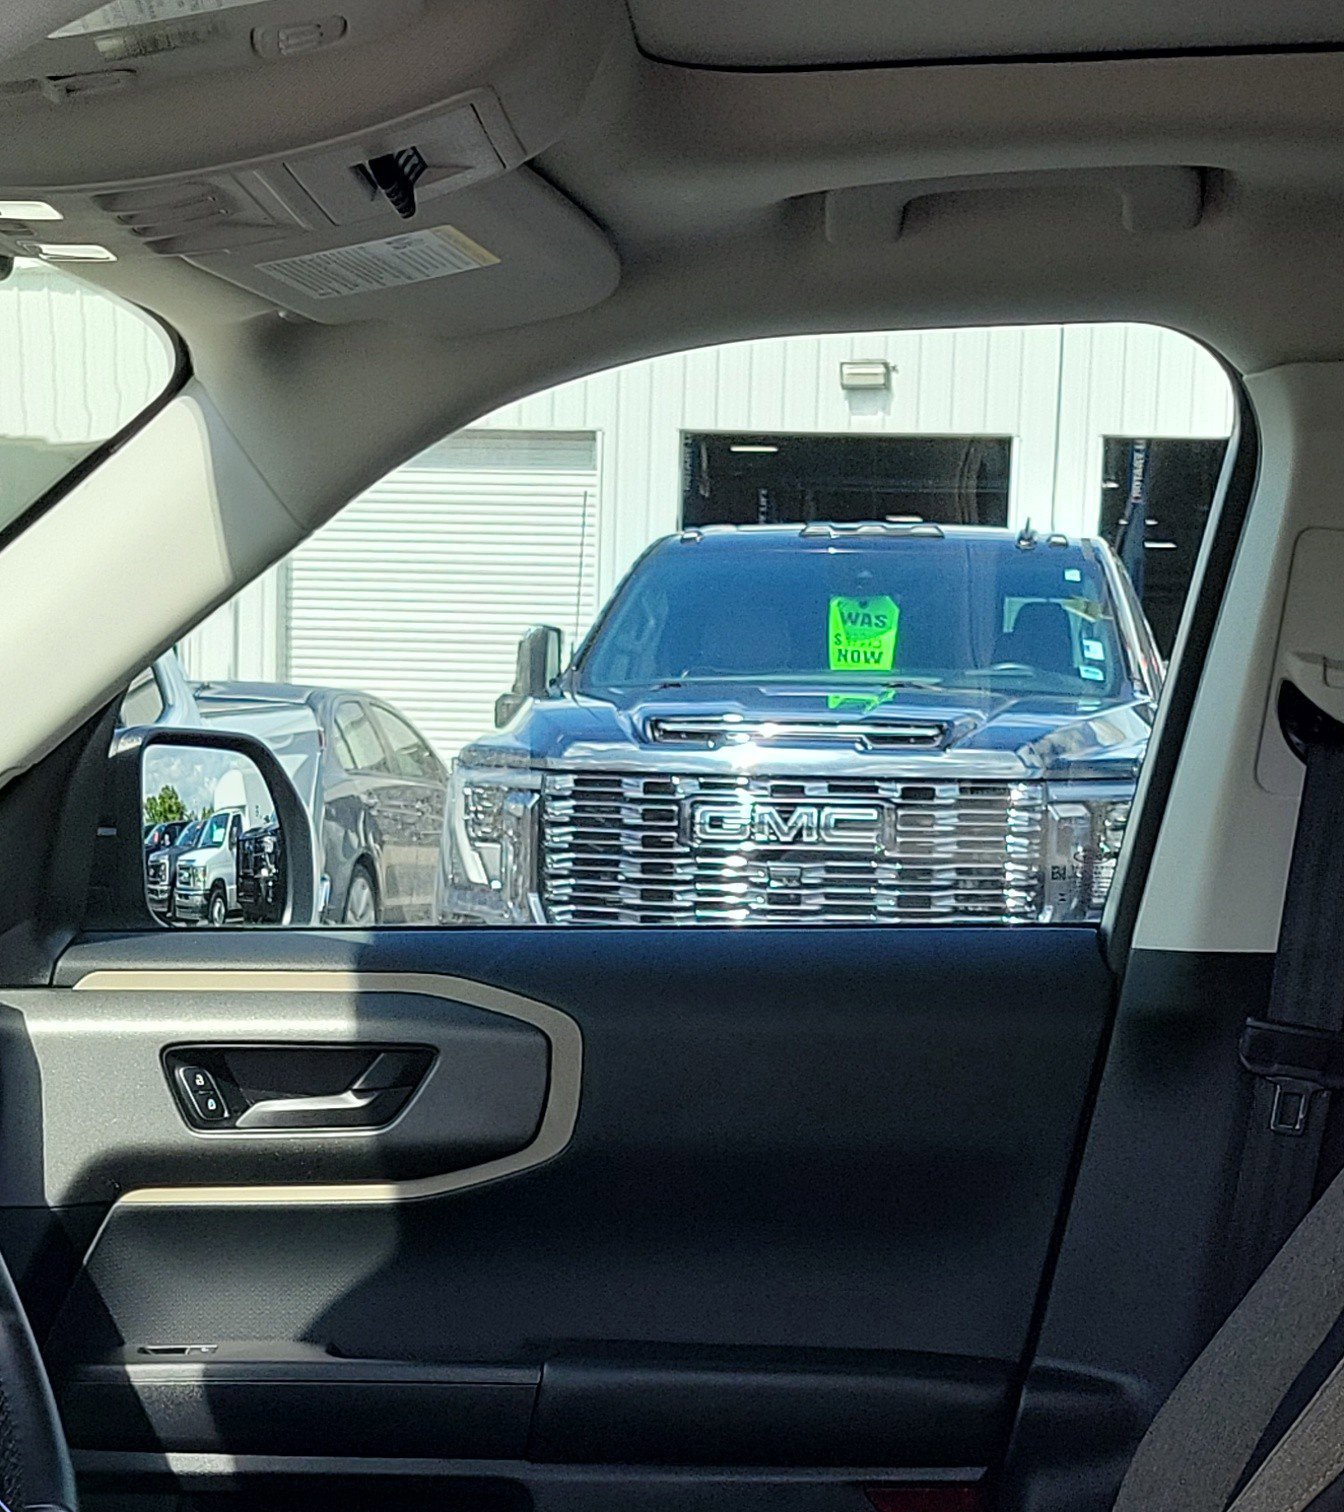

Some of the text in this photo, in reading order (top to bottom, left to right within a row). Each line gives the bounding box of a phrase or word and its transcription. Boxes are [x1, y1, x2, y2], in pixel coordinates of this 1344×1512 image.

[841, 612, 888, 629] WAS
[837, 648, 884, 664] NOW
[694, 803, 880, 845] GMC
